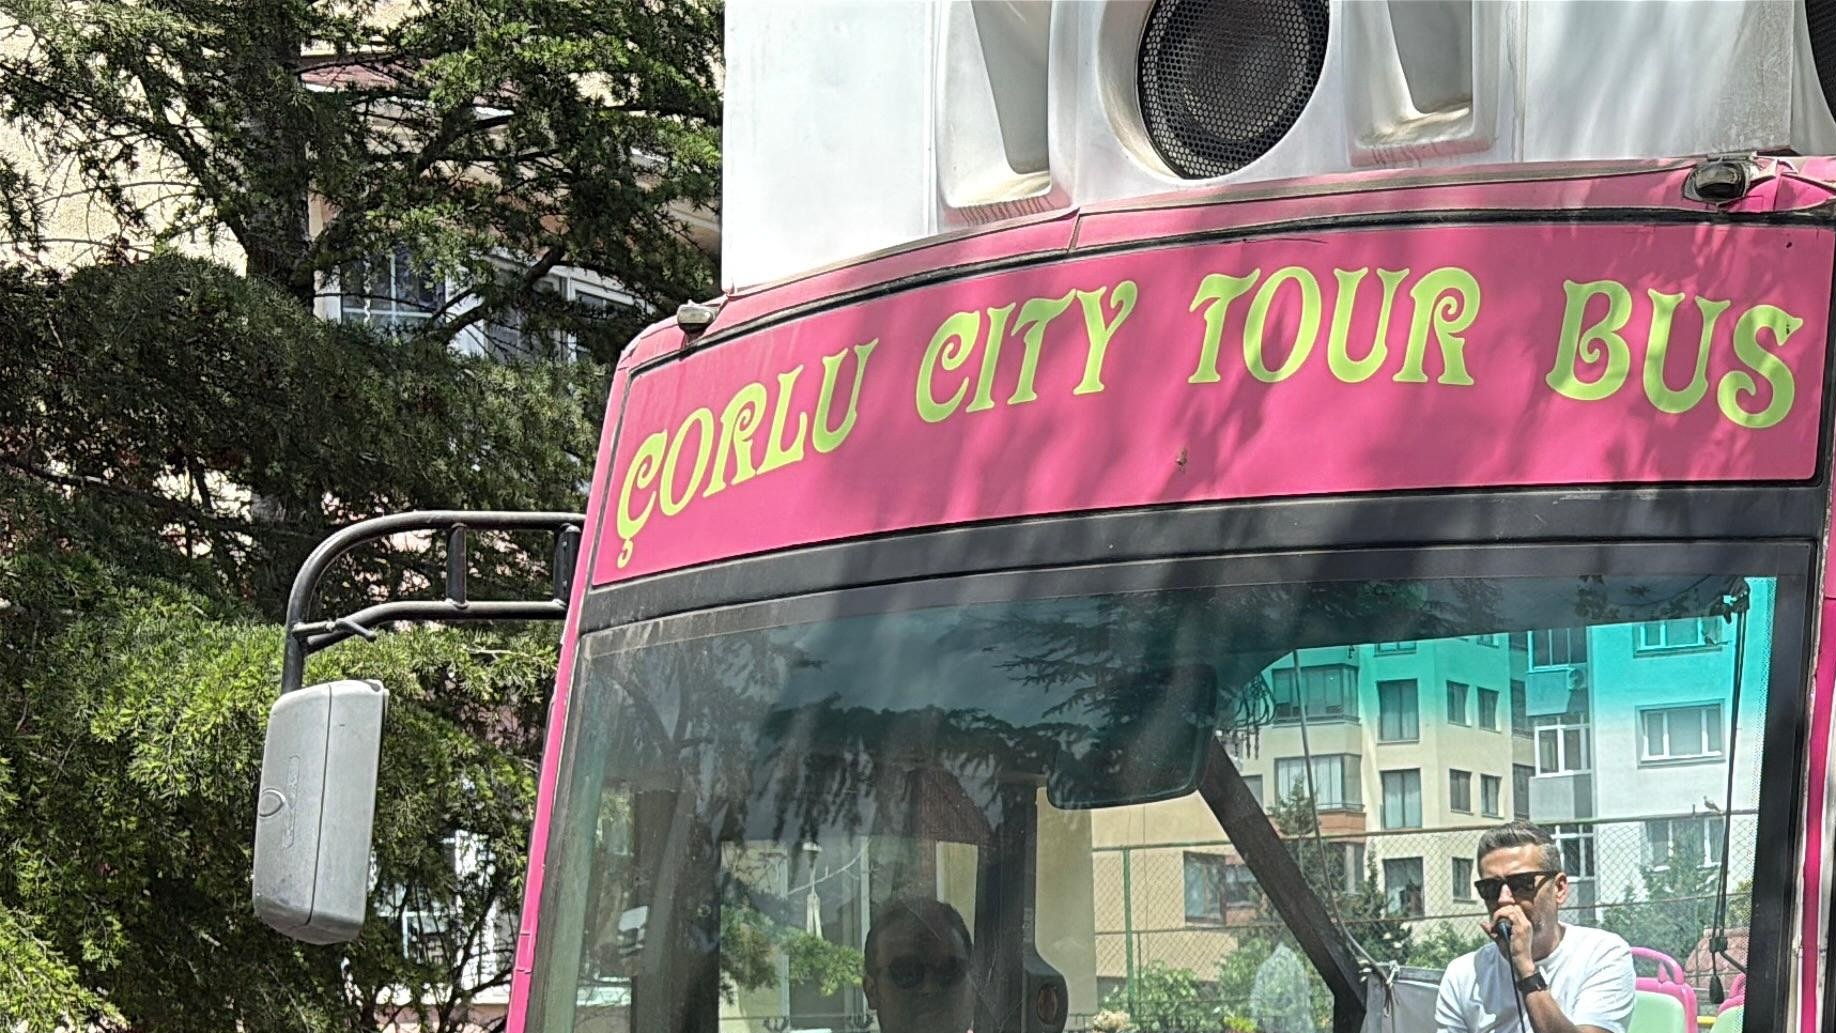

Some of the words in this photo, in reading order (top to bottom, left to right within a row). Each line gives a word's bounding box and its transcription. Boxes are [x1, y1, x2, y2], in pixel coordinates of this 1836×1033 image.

[616, 338, 879, 569] ÇORLU
[914, 279, 1138, 424] CITY
[1188, 264, 1480, 387] TOUR
[1545, 277, 1804, 429] BUS
